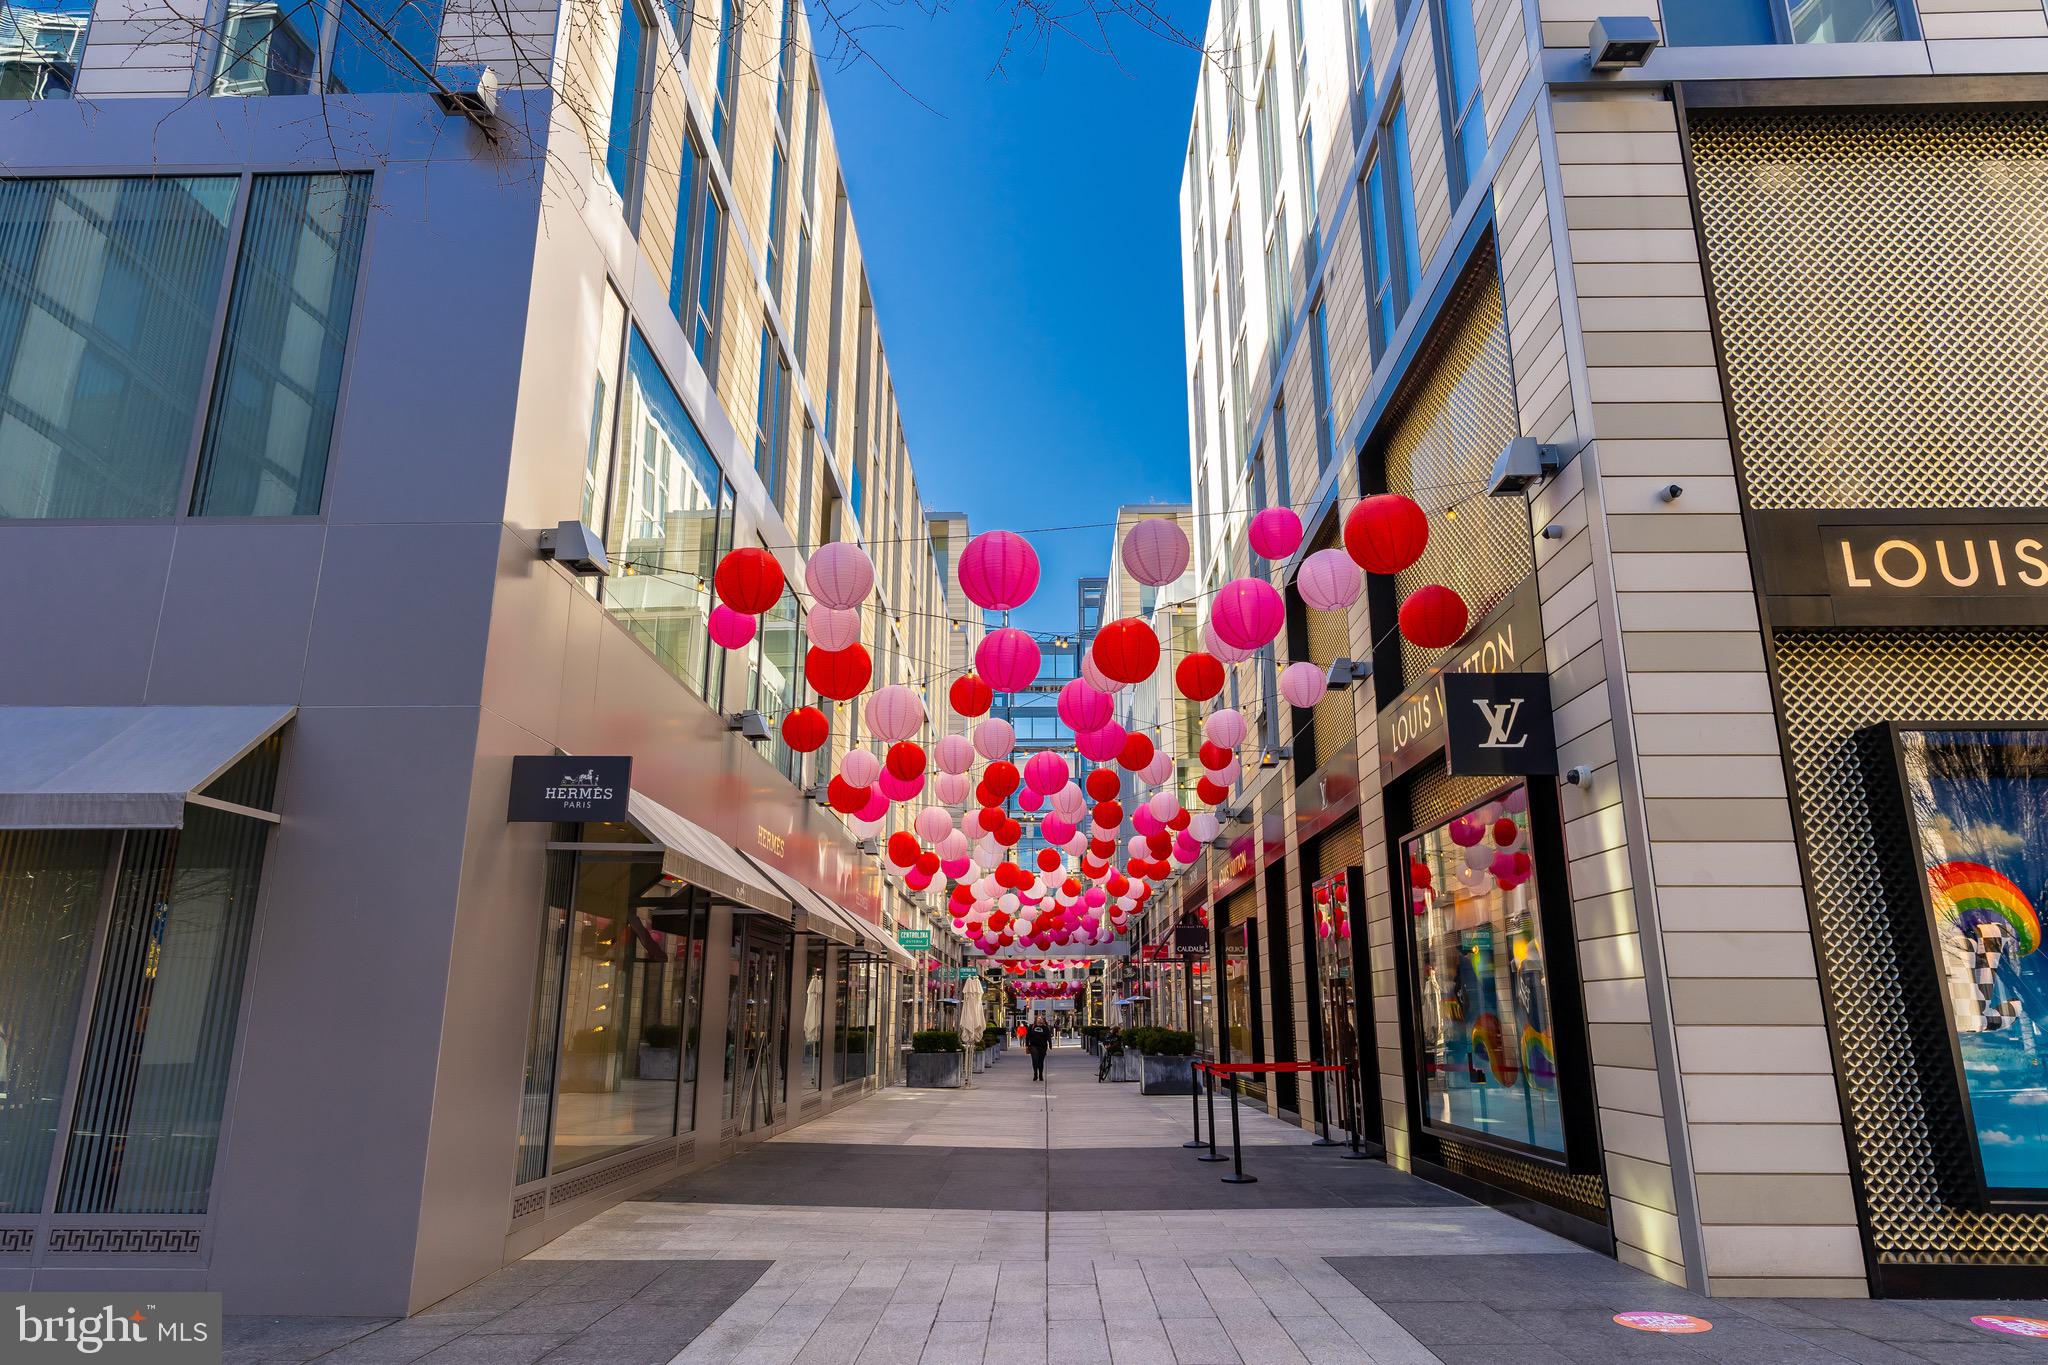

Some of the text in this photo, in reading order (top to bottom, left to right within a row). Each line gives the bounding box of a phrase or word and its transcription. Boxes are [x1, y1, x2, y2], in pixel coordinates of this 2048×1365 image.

[1840, 538, 2048, 588] LOUIS
[1391, 623, 1515, 753] LOUIS TTON
[563, 801, 592, 809] PARIS
